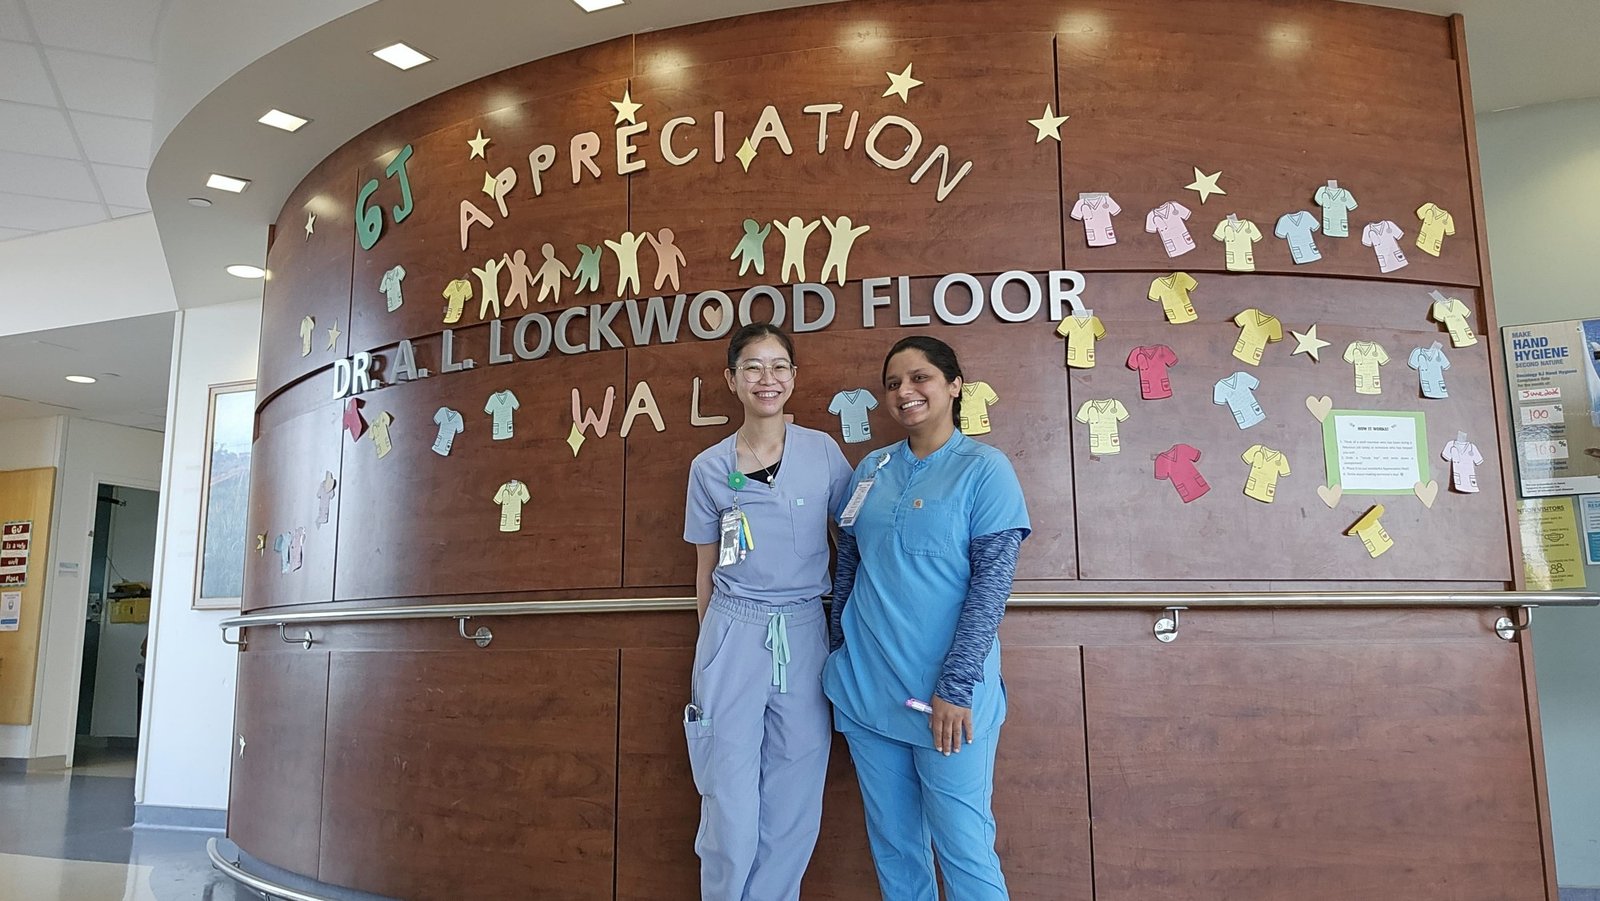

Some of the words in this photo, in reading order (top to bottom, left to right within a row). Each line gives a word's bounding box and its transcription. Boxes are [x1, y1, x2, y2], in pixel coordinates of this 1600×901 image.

[356, 144, 414, 250] 6J
[460, 103, 973, 251] APPRECIATION
[333, 351, 382, 400] DR.
[389, 339, 430, 383] A.
[441, 329, 475, 374] L.
[489, 283, 836, 365] LOCKWOOD
[862, 270, 1087, 328] FLOOR
[1513, 336, 1548, 350] HAND
[1514, 346, 1569, 361] HYGIENE
[571, 376, 794, 438] WAL
[1529, 409, 1549, 421] 100
